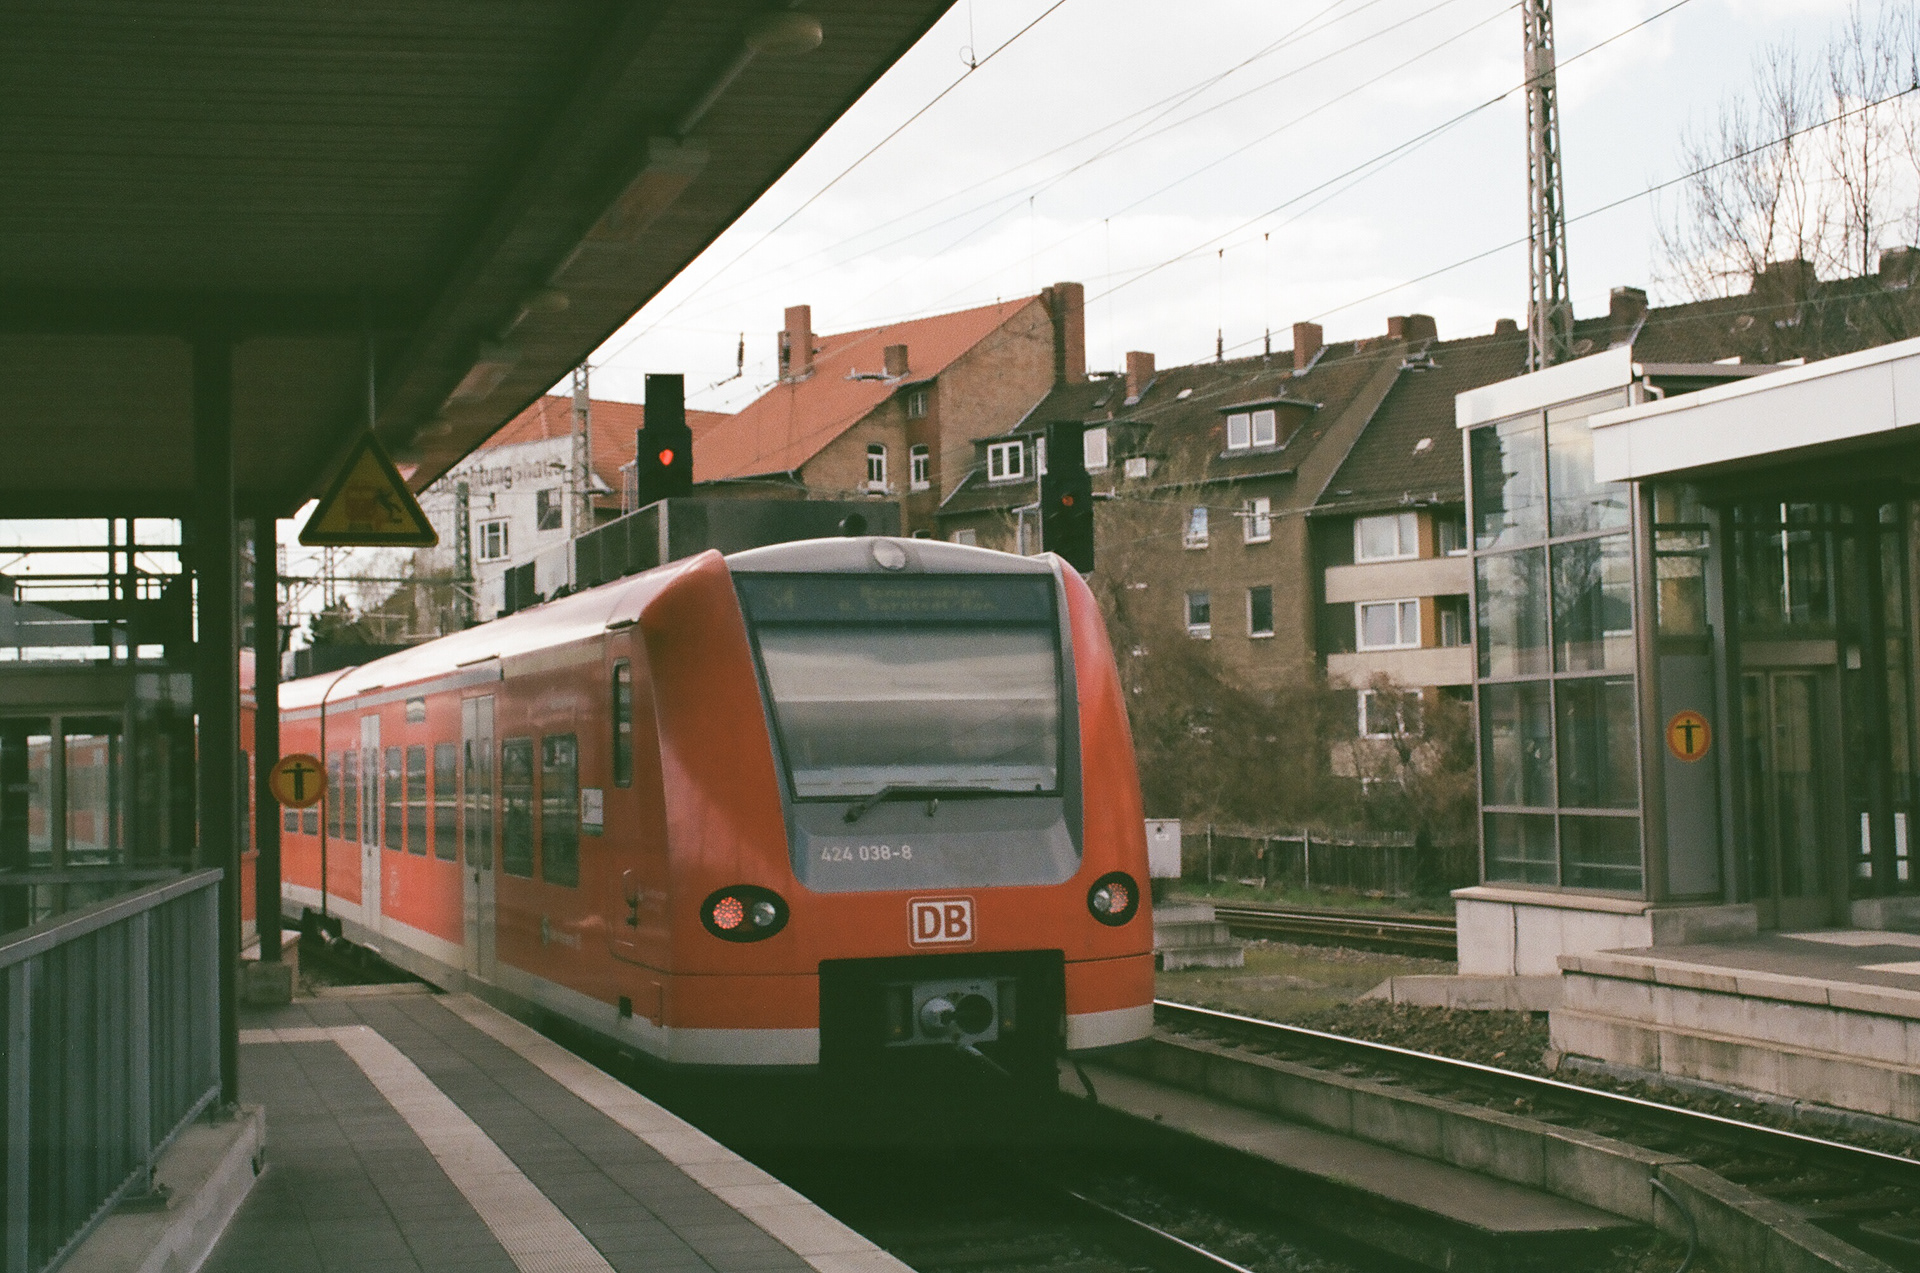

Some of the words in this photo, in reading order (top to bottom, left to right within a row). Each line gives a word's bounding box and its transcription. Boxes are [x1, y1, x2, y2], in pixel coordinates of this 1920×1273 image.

[821, 846, 852, 862] 424
[859, 844, 913, 861] 038-8
[916, 903, 968, 940] DB
